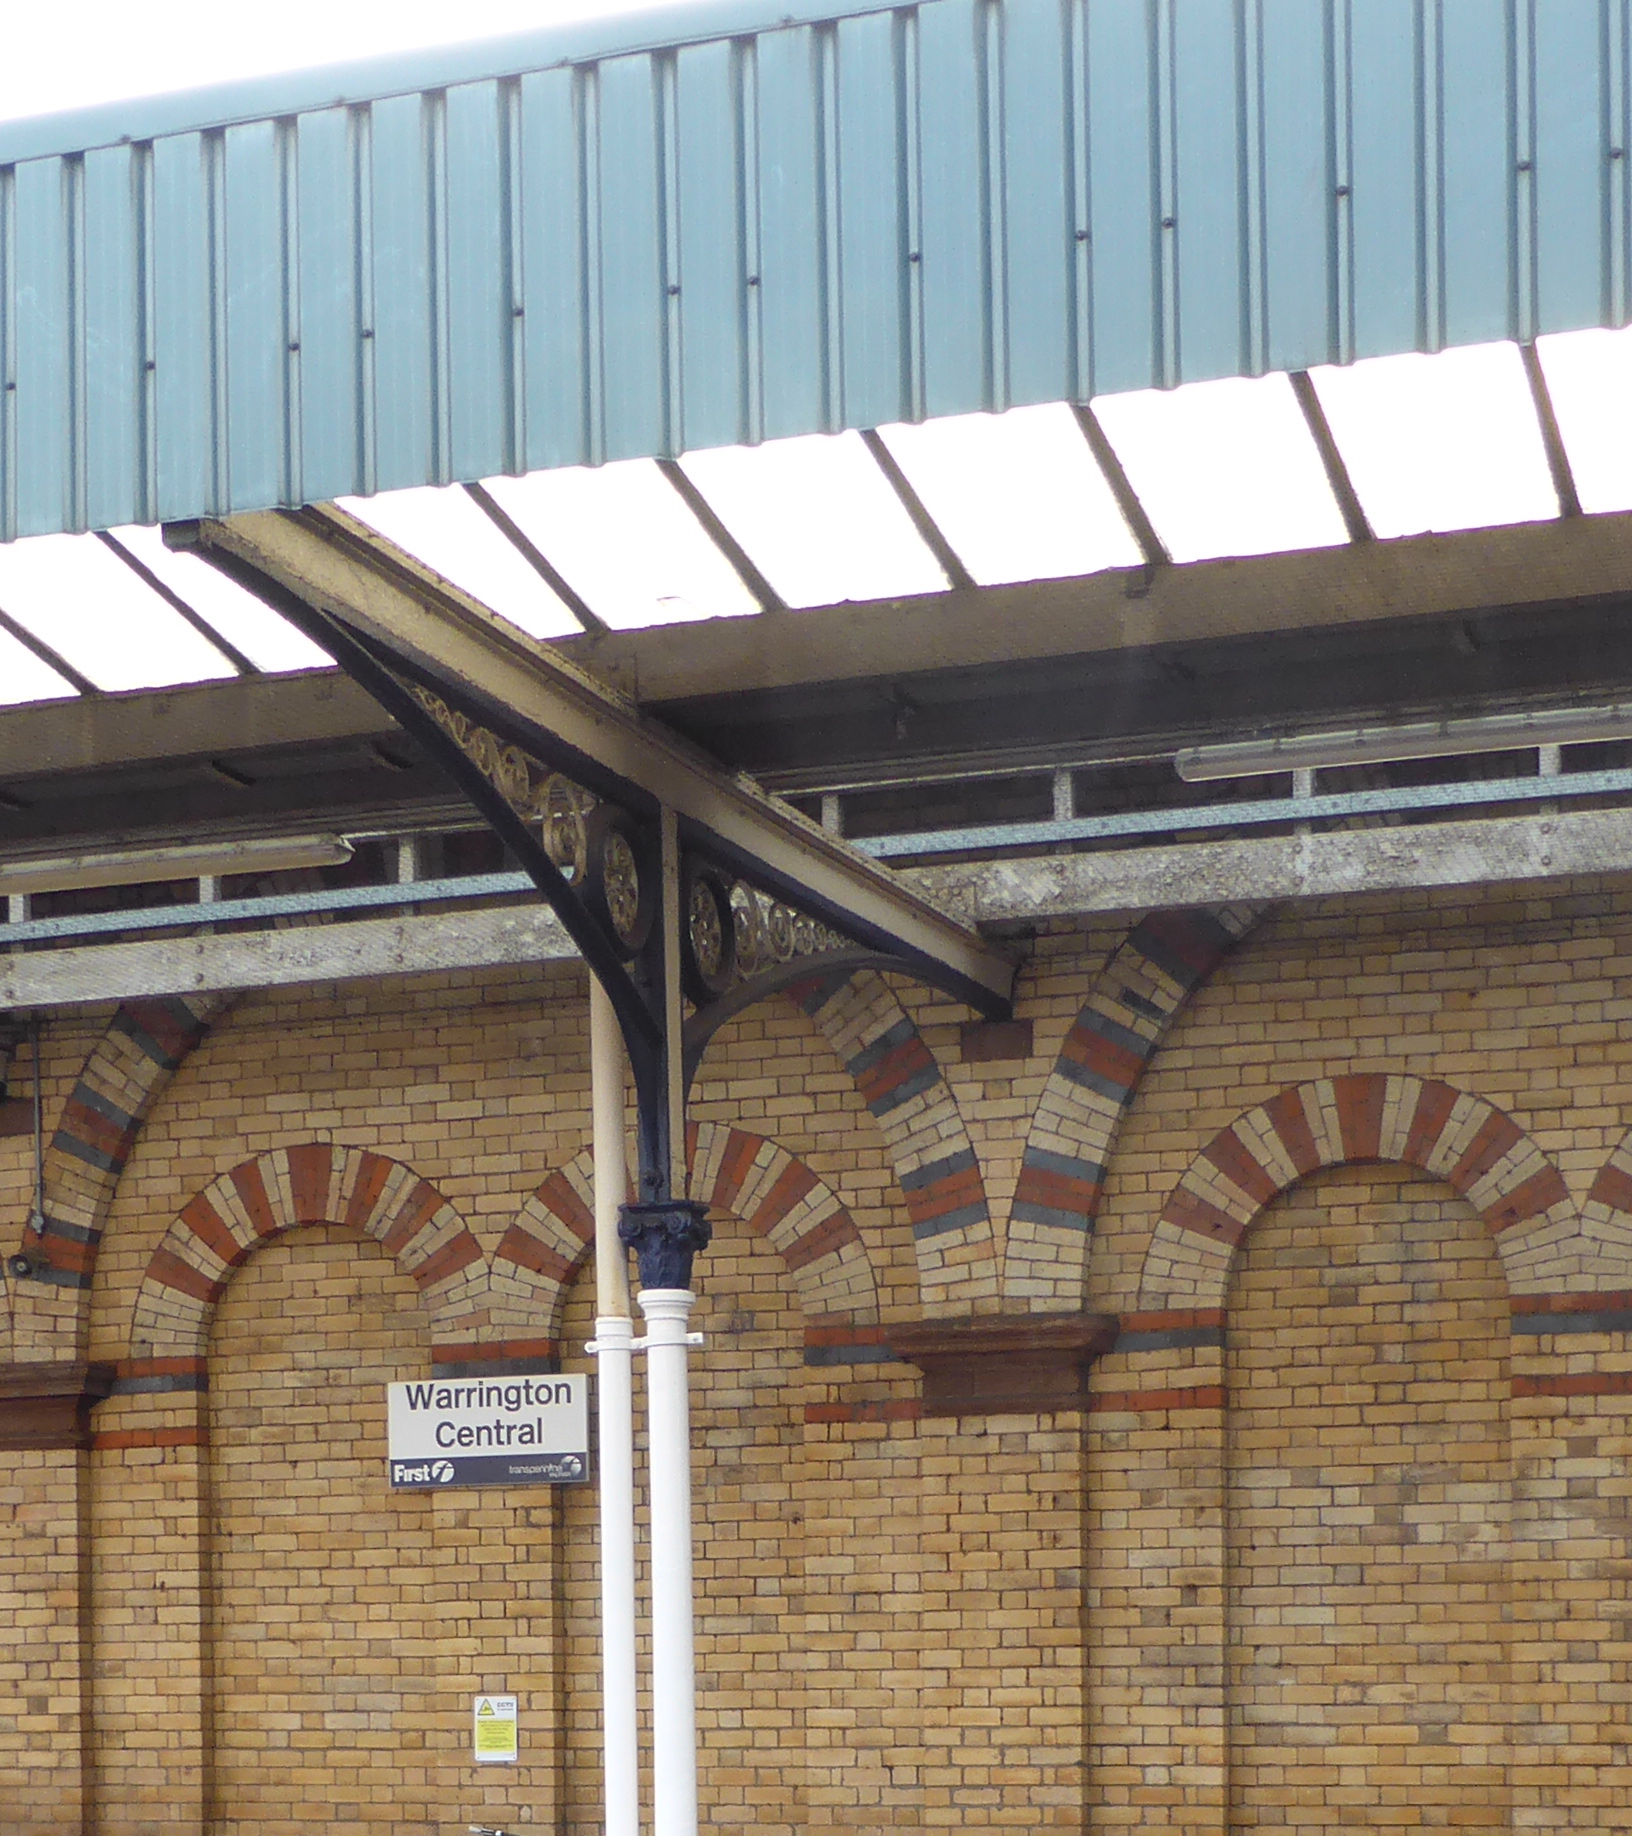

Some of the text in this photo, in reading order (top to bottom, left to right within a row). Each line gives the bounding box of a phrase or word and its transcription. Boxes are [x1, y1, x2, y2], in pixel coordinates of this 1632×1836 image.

[405, 1379, 572, 1411] Warrington
[435, 1417, 543, 1448] Central
[394, 1464, 430, 1483] First
